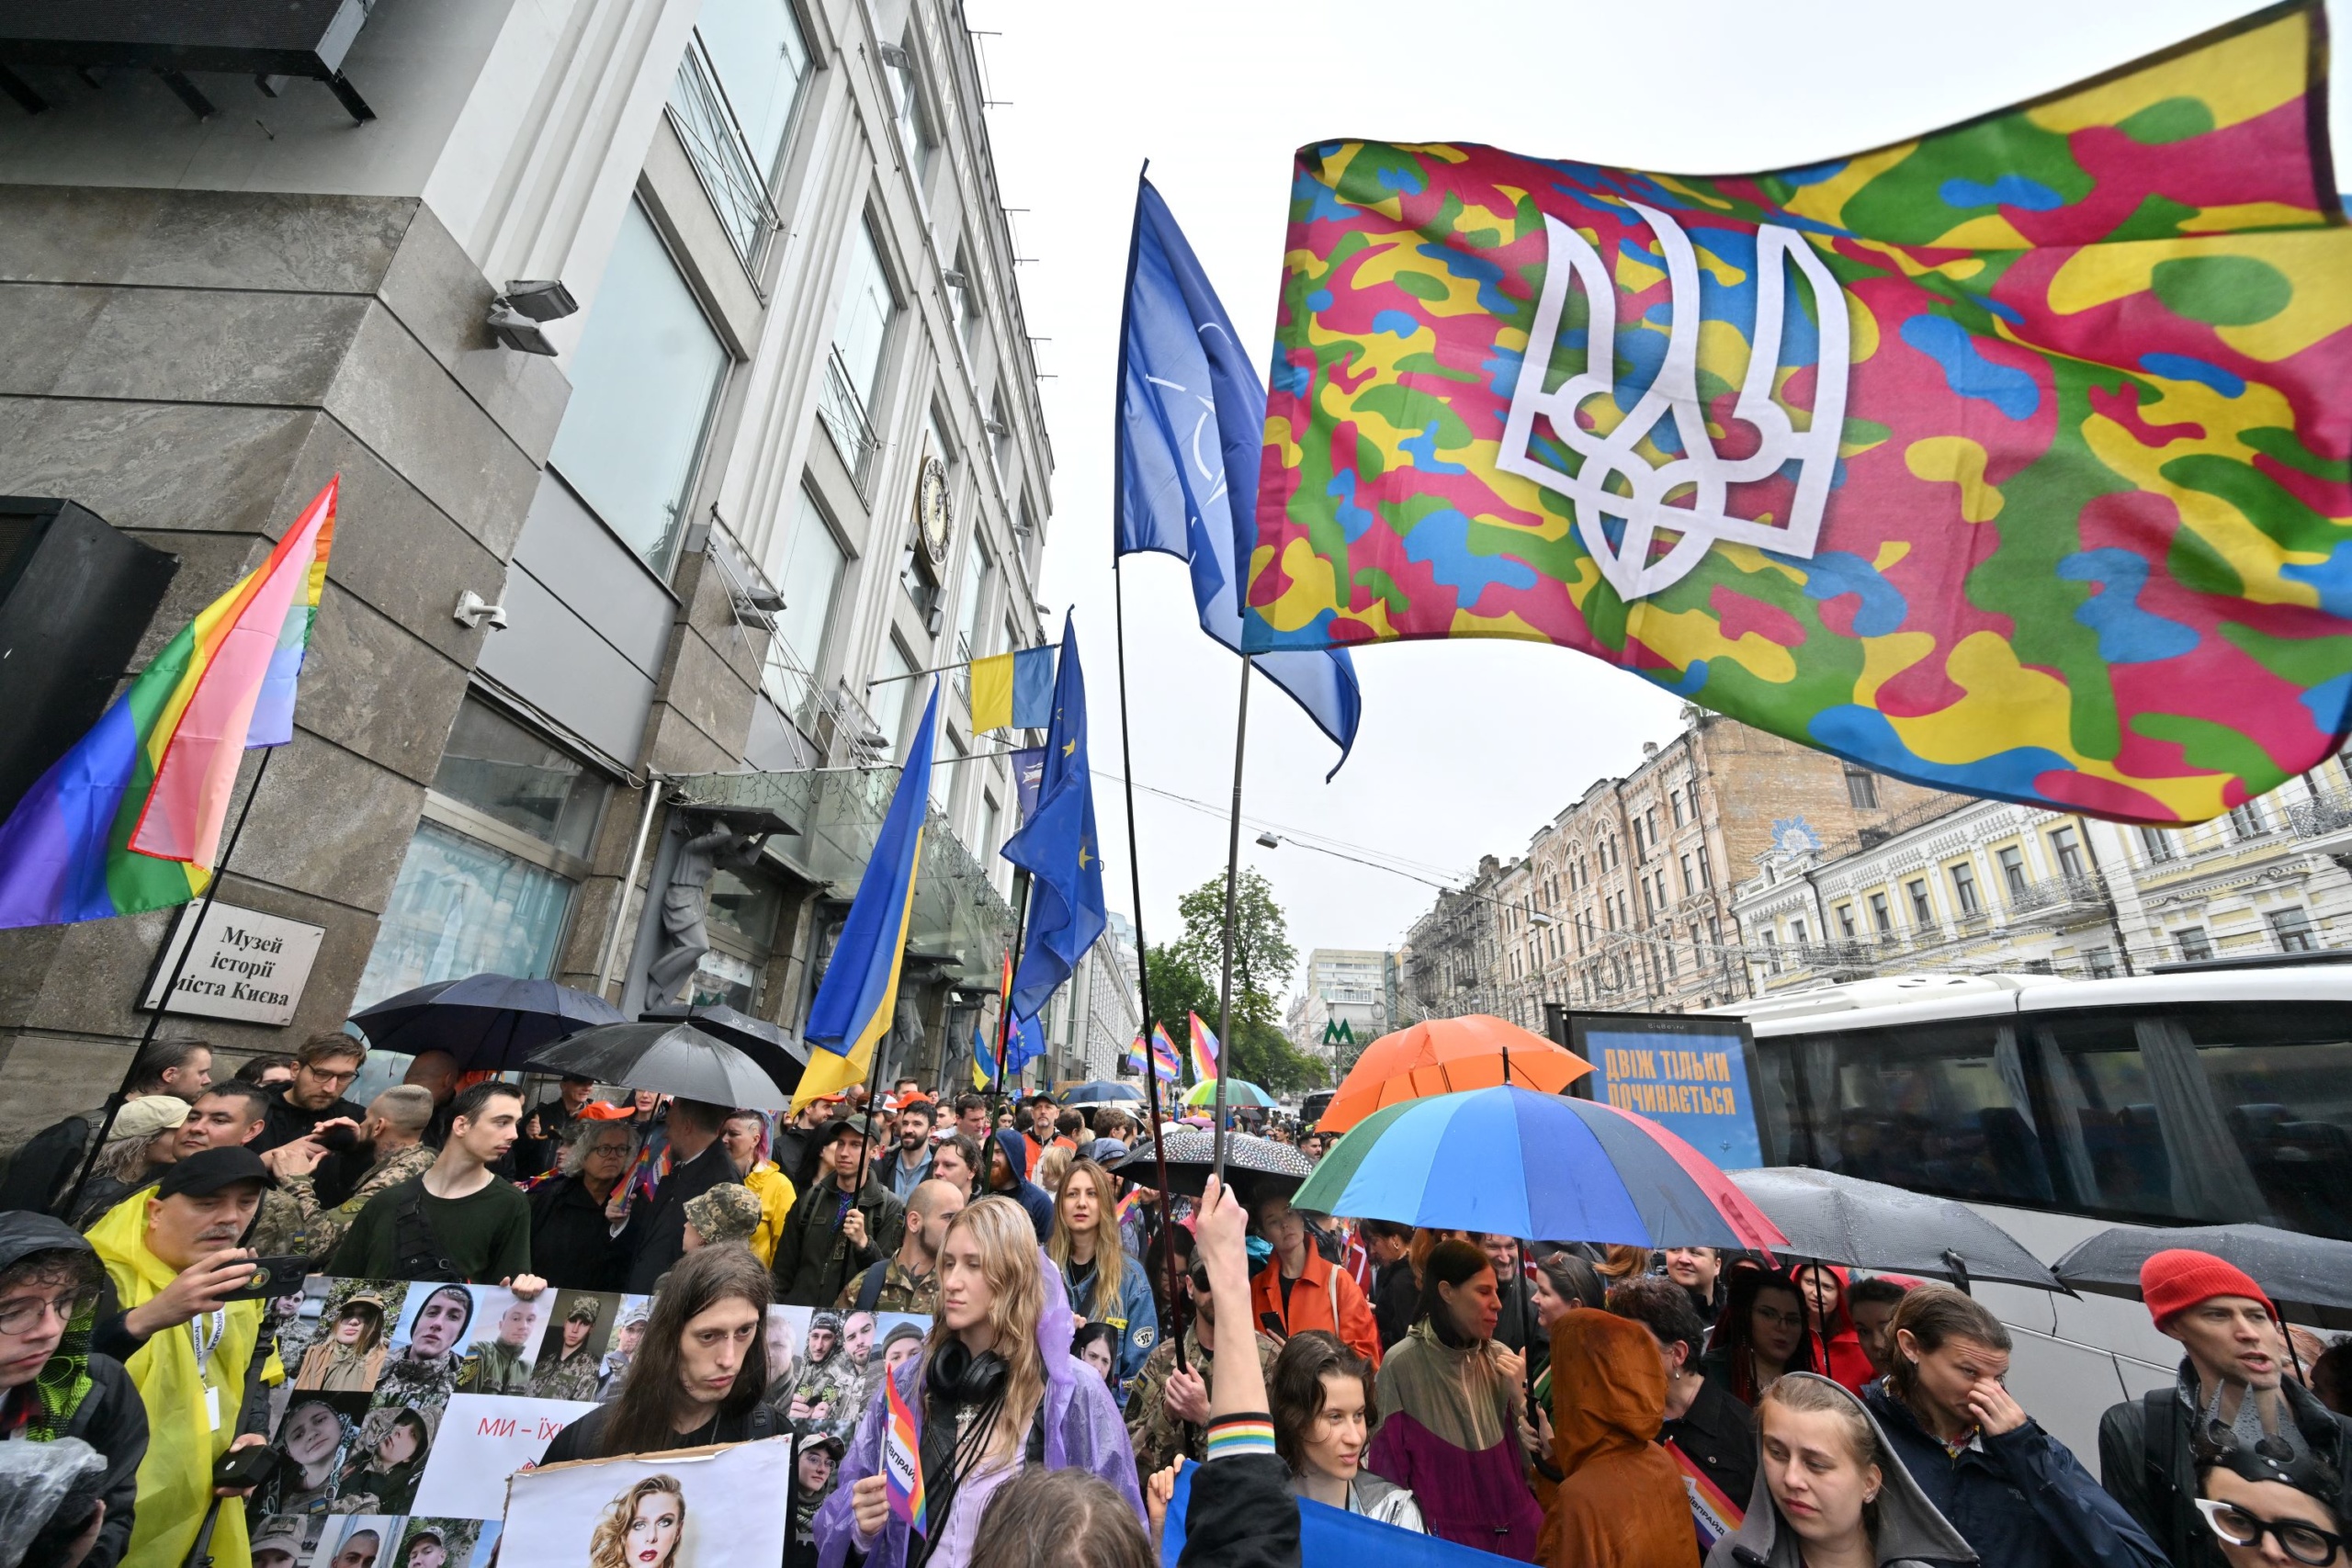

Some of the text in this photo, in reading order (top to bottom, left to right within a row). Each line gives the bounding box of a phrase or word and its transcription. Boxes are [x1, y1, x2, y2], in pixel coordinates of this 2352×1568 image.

[220, 926, 283, 953] Музей
[209, 951, 276, 979] історії
[230, 981, 289, 1007] Києва
[1604, 1048, 1731, 1082] ДВІЖ ТІЛЬКИ
[1607, 1083, 1736, 1115] ПОЧИНАЄТЬСЯ
[477, 1417, 516, 1438] МИ
[1688, 1495, 1724, 1536] ЇВПРАЙД
